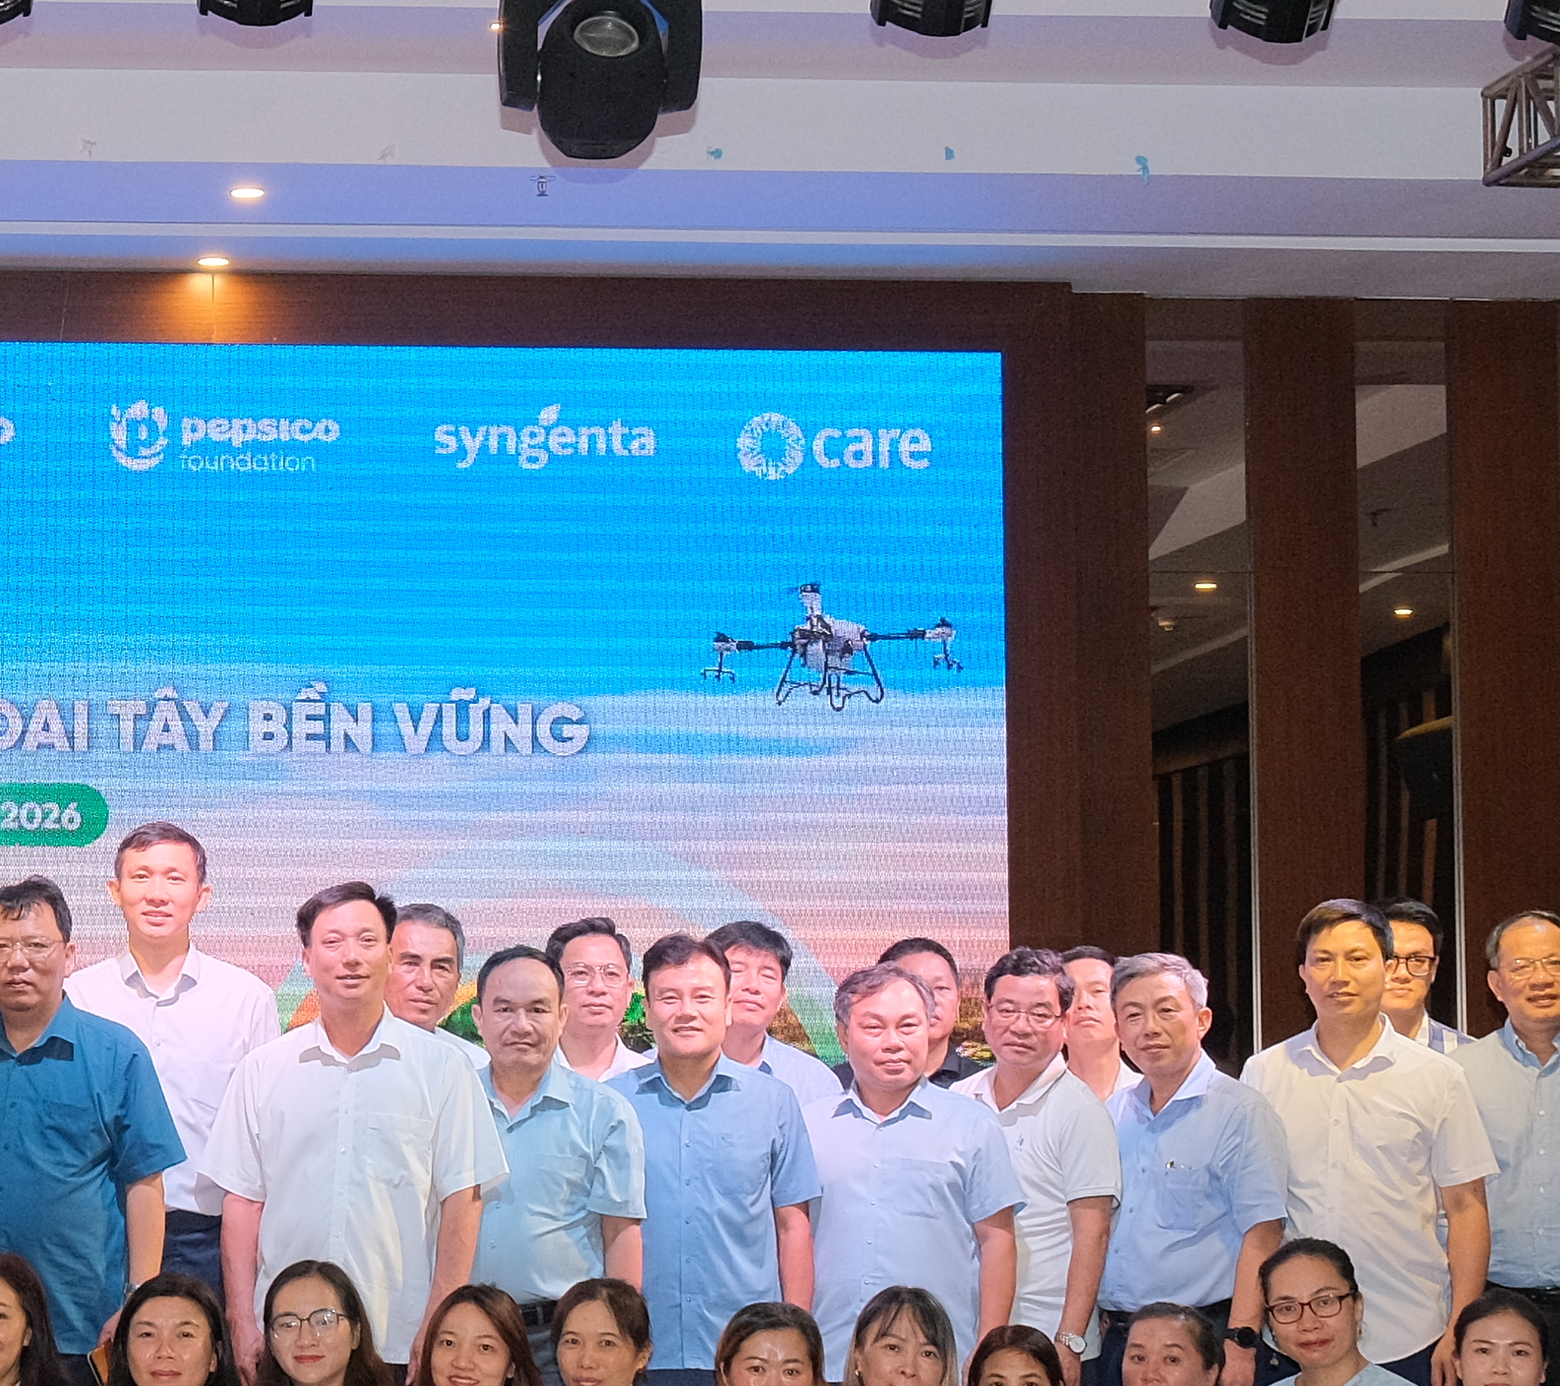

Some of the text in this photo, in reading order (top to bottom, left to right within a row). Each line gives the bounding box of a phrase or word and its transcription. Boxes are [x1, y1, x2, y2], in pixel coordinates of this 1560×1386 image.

[181, 417, 341, 448] pepsico
[434, 416, 656, 471] syngenta
[811, 426, 933, 470] care
[180, 450, 317, 472] foundation
[107, 686, 230, 754] TÂY
[248, 681, 375, 755] BỀN
[394, 686, 592, 757] VỮNG
[0, 800, 83, 831] 2026
